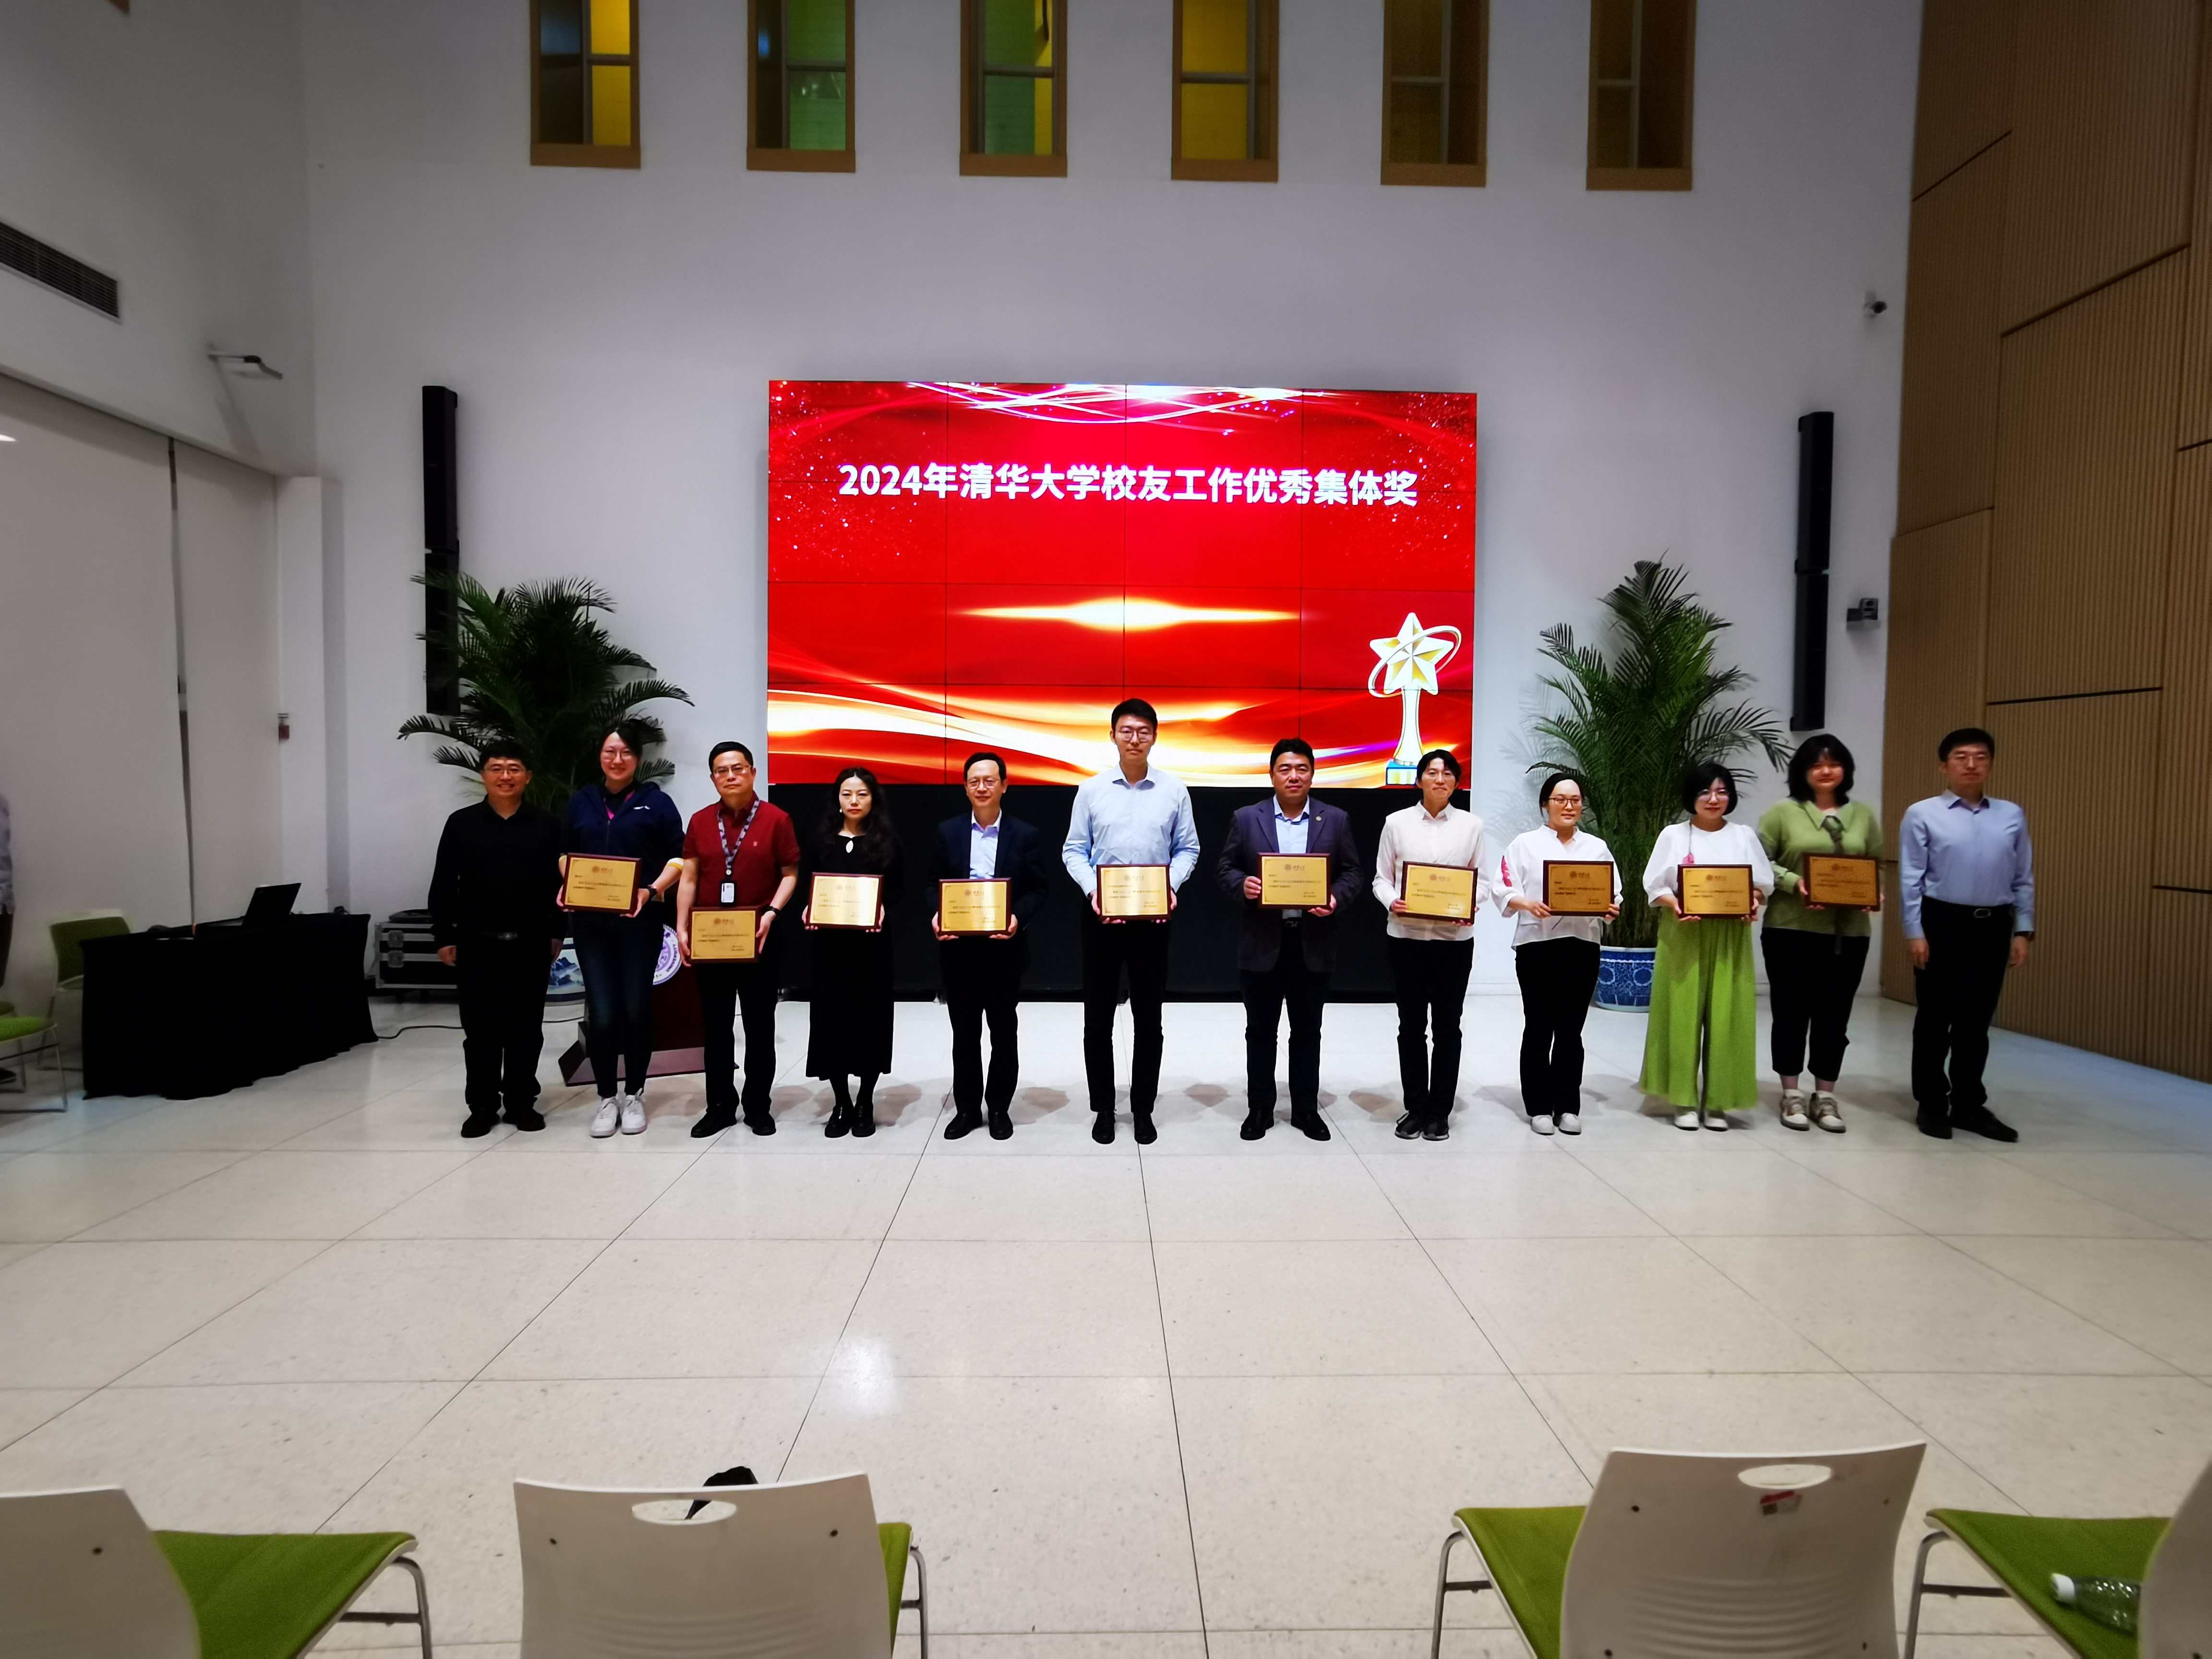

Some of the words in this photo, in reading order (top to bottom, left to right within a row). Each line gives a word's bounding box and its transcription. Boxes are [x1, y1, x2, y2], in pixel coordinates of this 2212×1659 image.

[839, 462, 1418, 506] 2024年清华大学校友工作优秀集体奖
